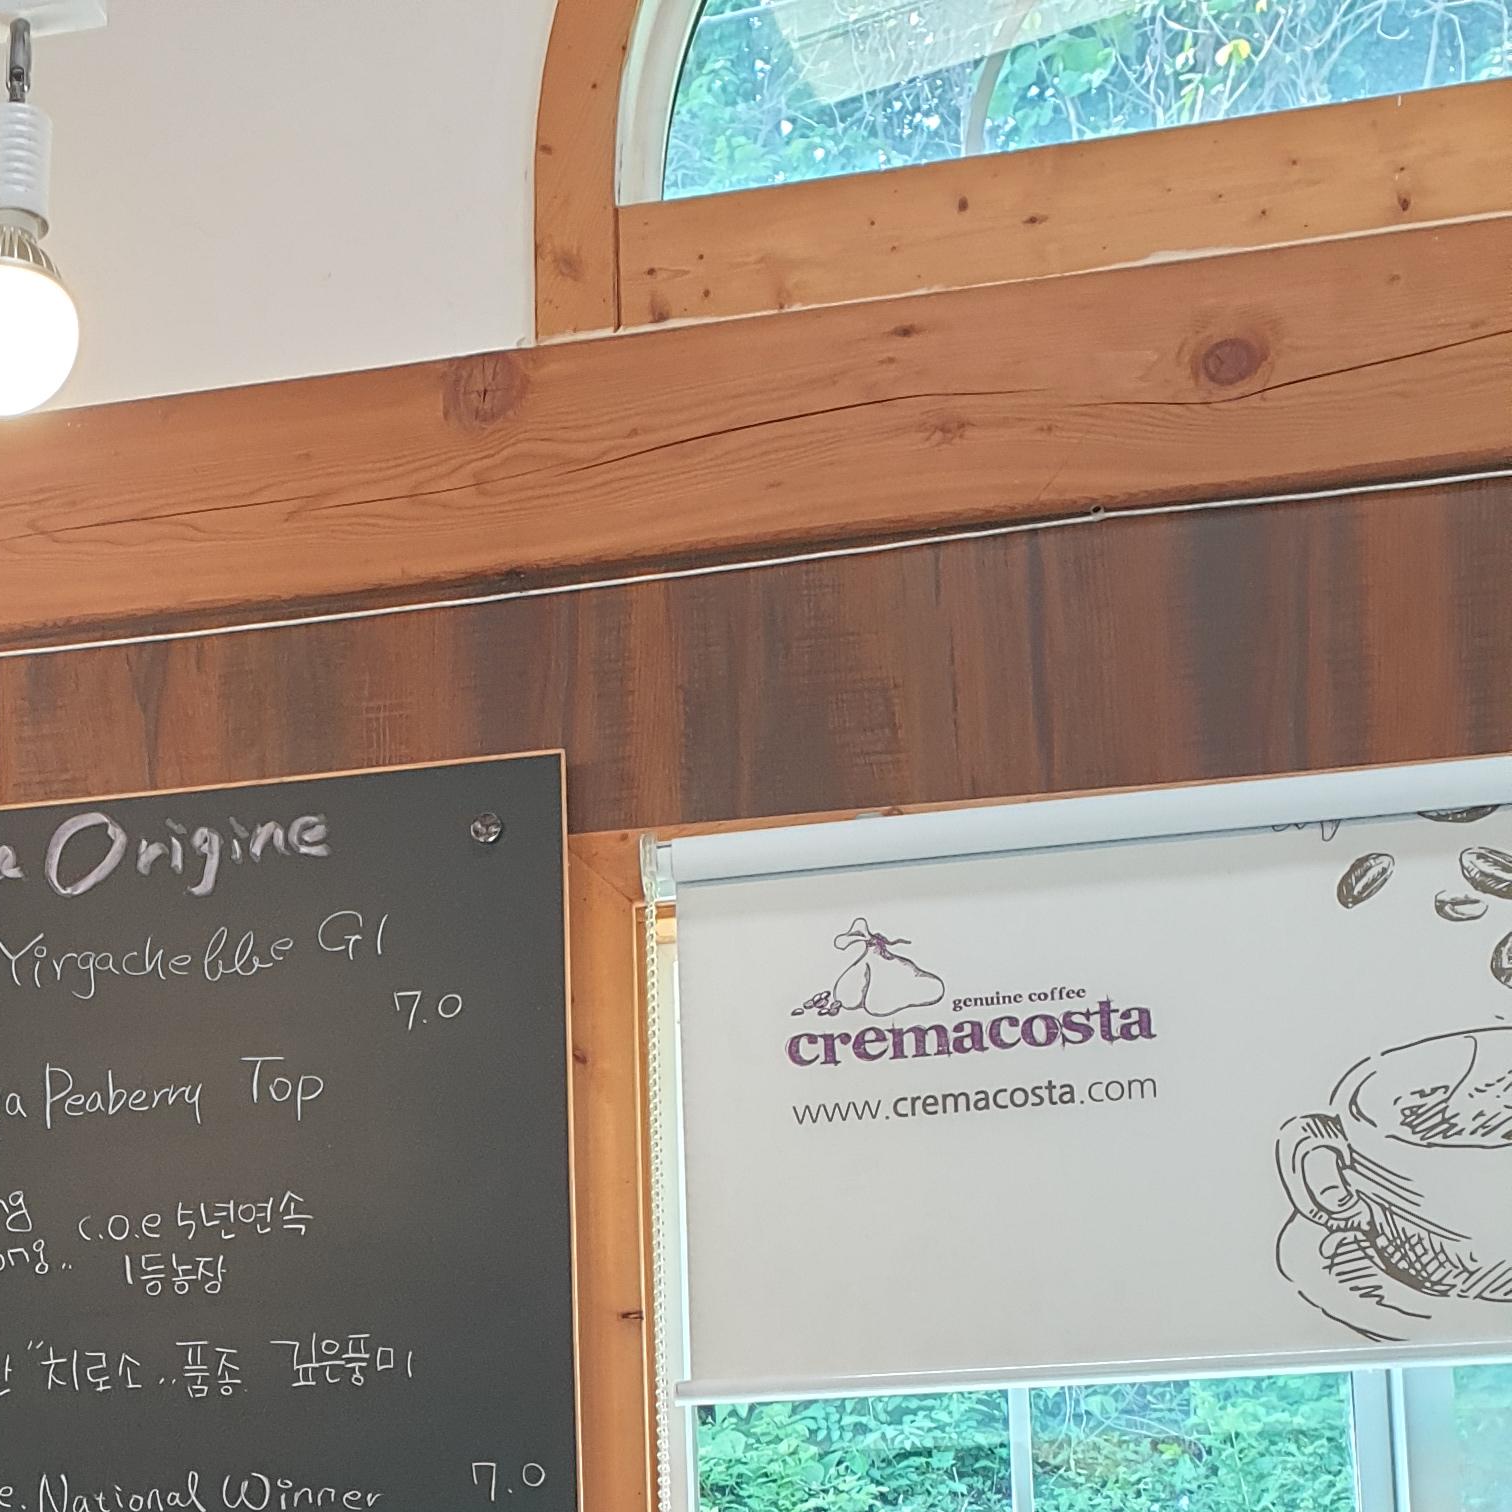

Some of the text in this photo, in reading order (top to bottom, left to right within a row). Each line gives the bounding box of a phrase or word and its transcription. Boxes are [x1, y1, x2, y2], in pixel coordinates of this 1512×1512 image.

[45, 811, 330, 897] Origine
[394, 991, 463, 1030] 7.0
[952, 986, 1087, 1012] genuine coffee
[785, 996, 1158, 1067] cremacosta
[39, 1062, 202, 1130] Peaberry
[241, 1057, 324, 1122] Top
[792, 1077, 1158, 1126] www.cremacosta.com
[177, 1190, 314, 1240] 5년연속
[125, 1253, 226, 1296] 1등농장
[222, 1473, 385, 1512] Winner
[472, 1462, 546, 1501] 7.0
